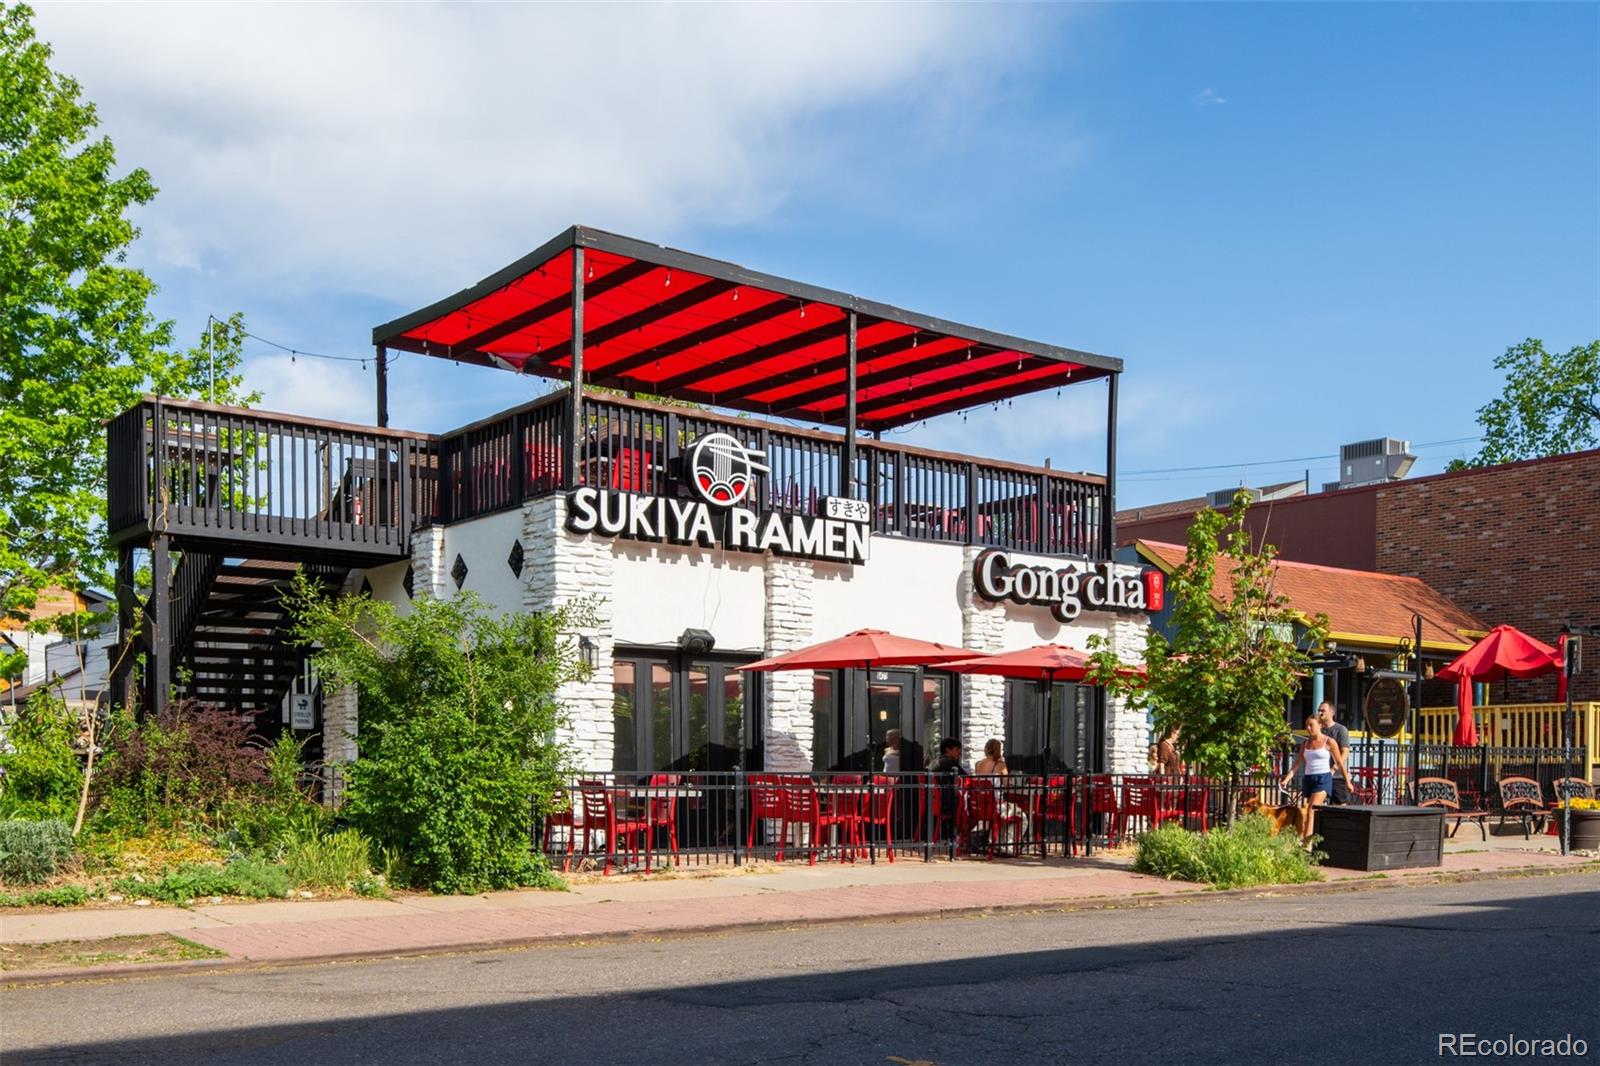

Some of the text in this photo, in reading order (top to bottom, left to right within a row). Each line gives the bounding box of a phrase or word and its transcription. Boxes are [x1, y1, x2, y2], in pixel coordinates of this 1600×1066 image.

[573, 487, 870, 560] SUKIYA RAMEN
[829, 498, 867, 519] すきや
[982, 550, 1082, 618] Gong
[1086, 561, 1147, 610] cha
